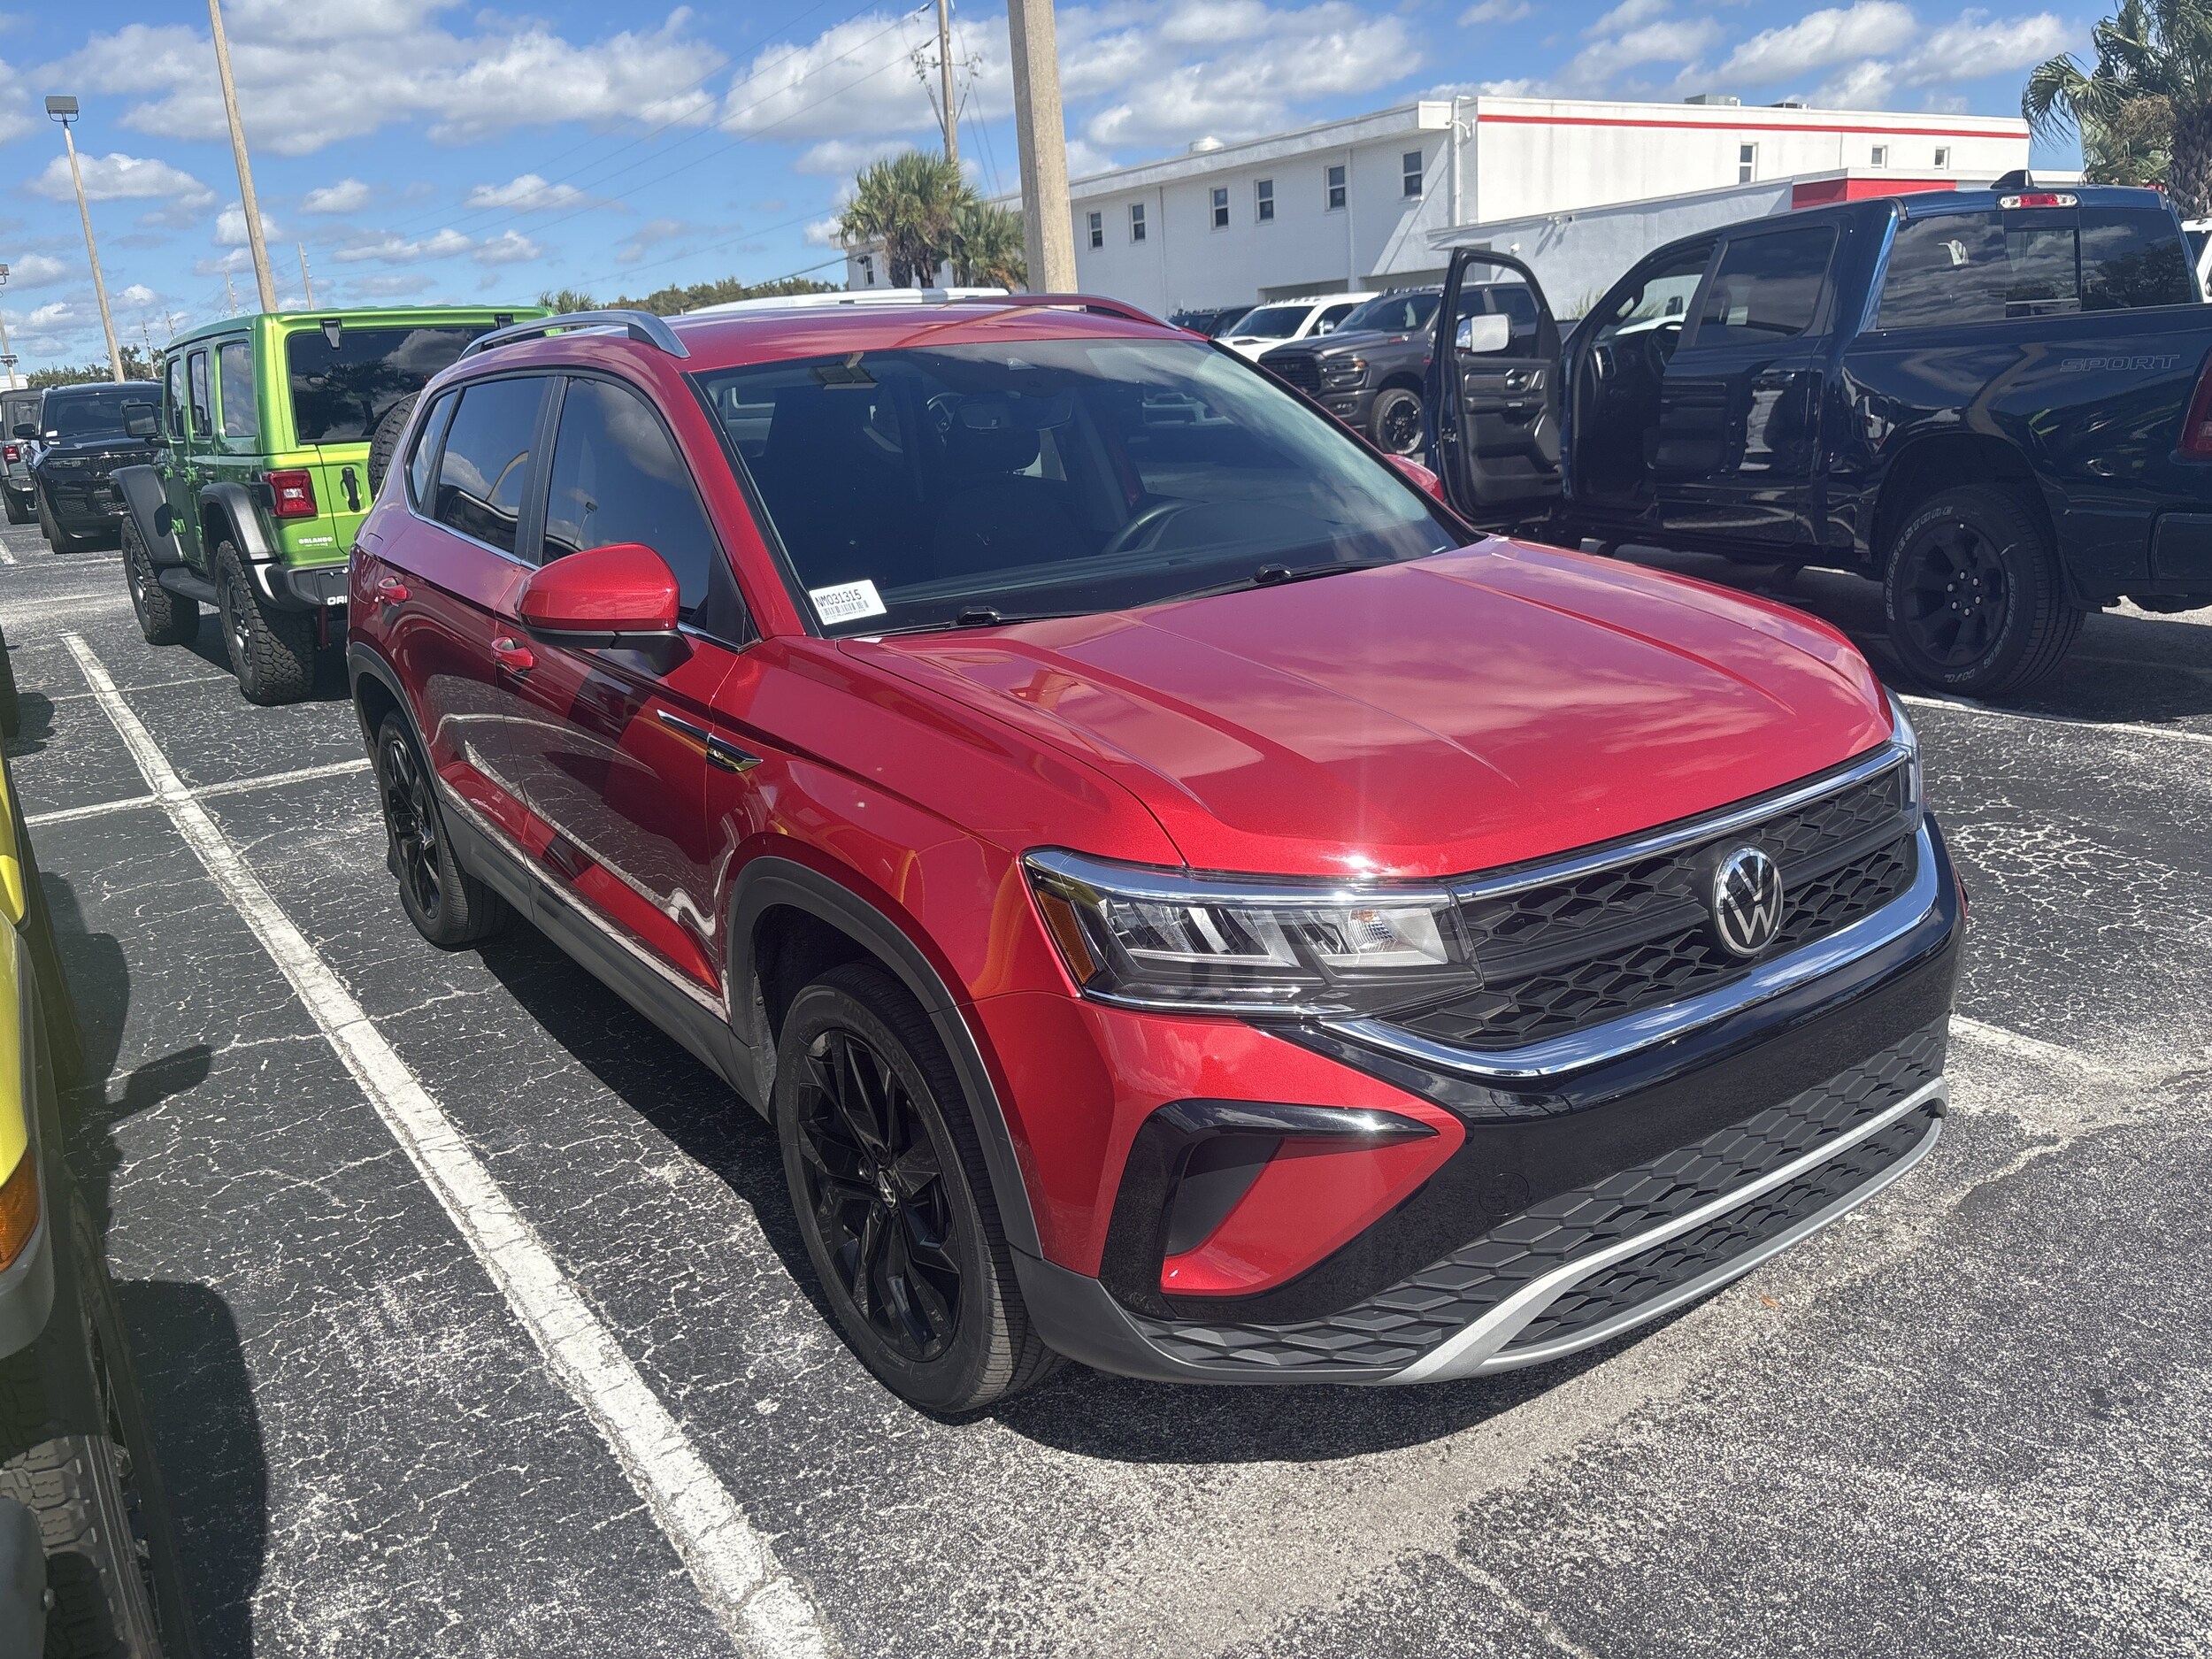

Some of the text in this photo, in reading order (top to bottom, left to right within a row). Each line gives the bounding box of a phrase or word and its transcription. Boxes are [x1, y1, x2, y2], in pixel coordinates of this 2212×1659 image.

[2060, 354, 2180, 373] SPORT
[815, 589, 862, 608] NM031315
[1717, 847, 1783, 951] VW
